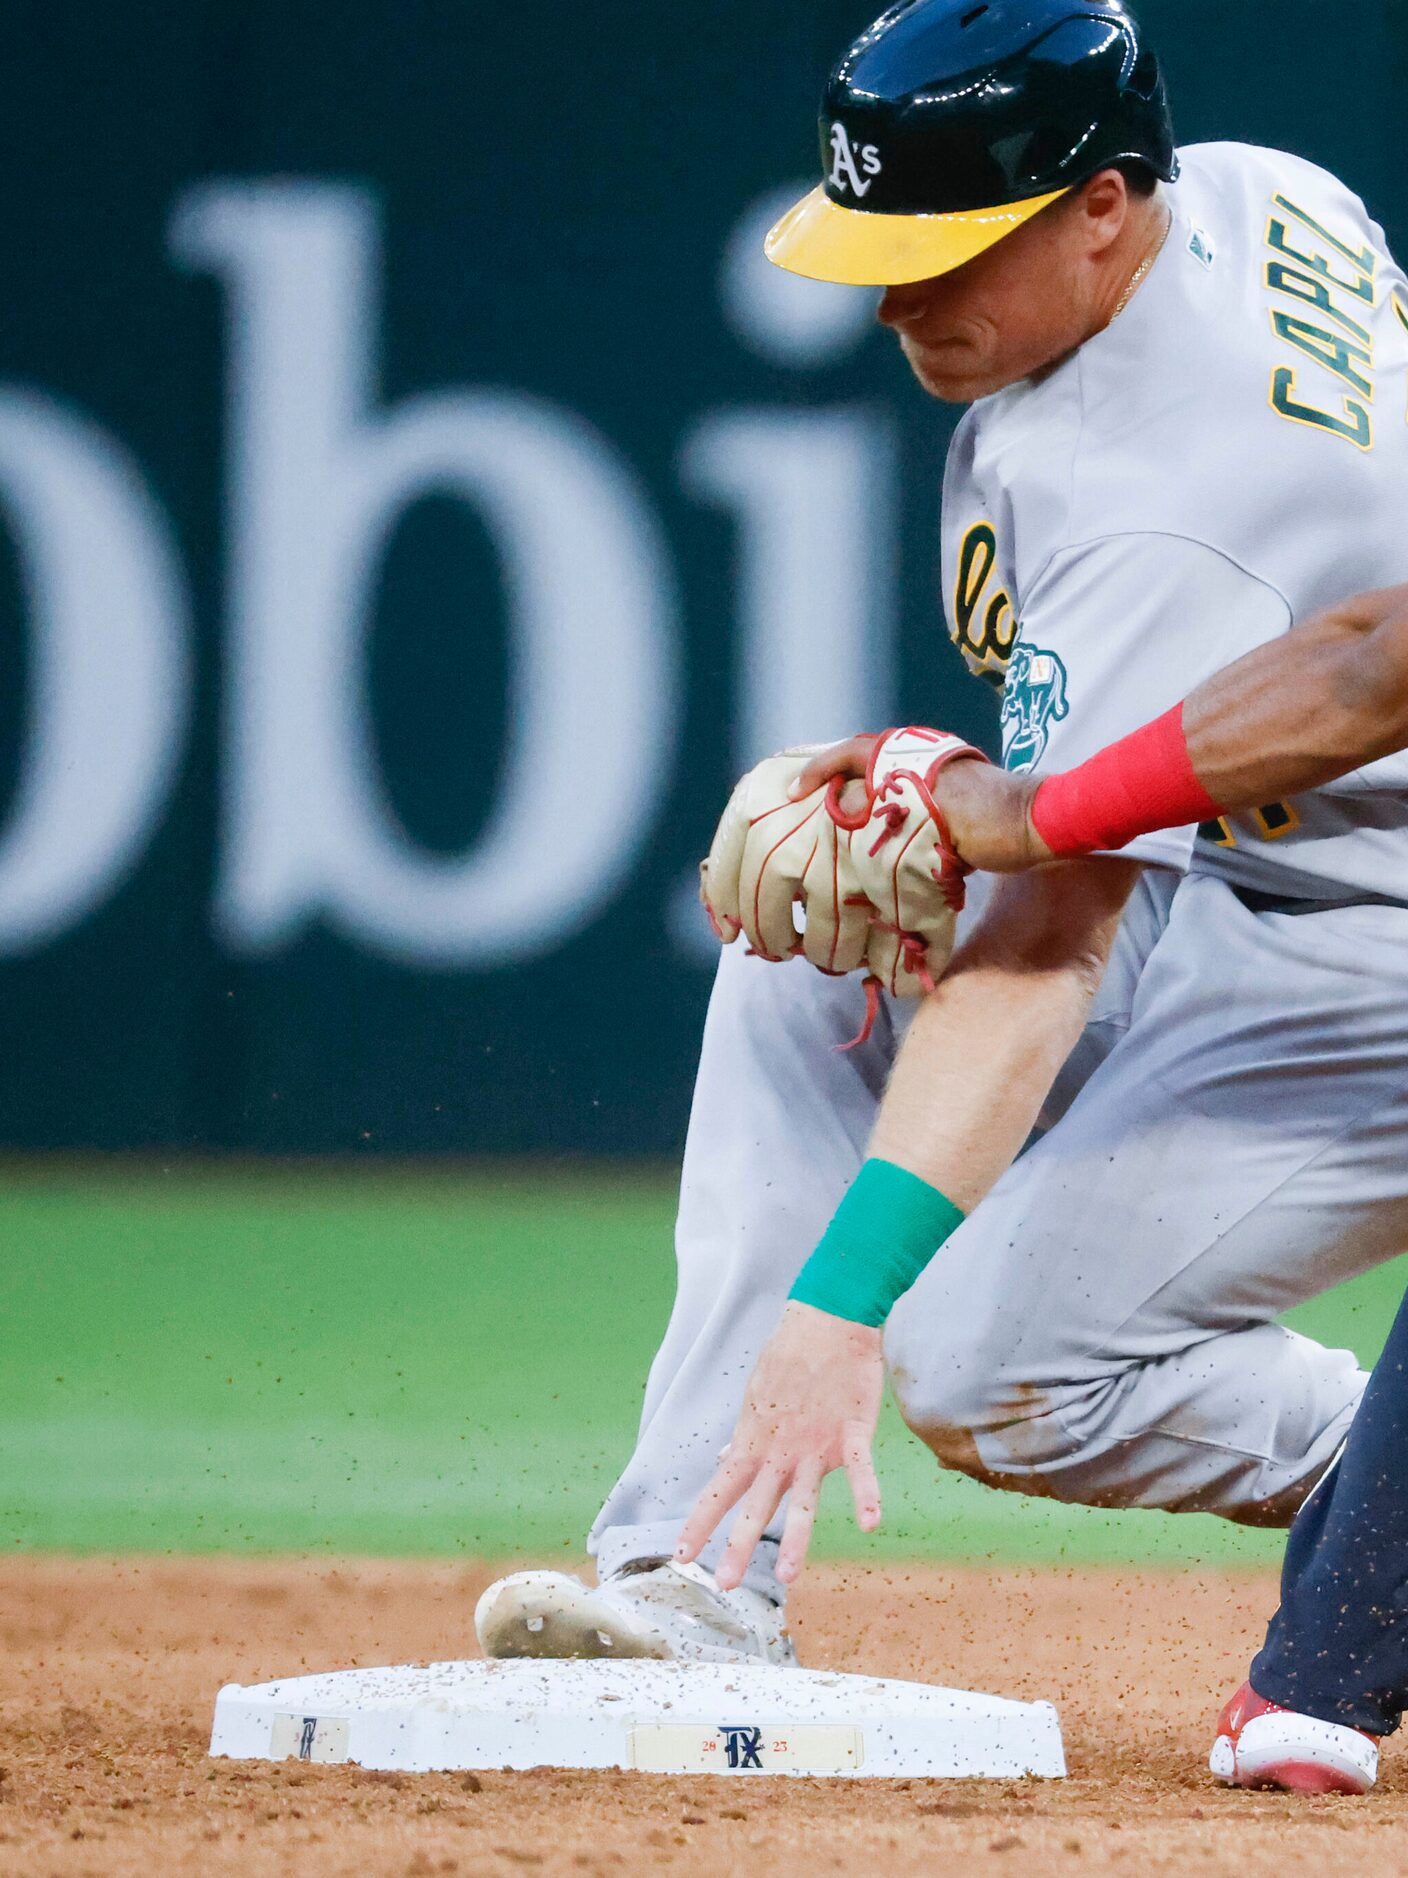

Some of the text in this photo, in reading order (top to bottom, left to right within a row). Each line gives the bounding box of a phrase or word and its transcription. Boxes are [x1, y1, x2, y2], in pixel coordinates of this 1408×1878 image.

[829, 121, 882, 197] A's
[1261, 190, 1377, 452] CAPEL
[773, 1740, 788, 1752] 23
